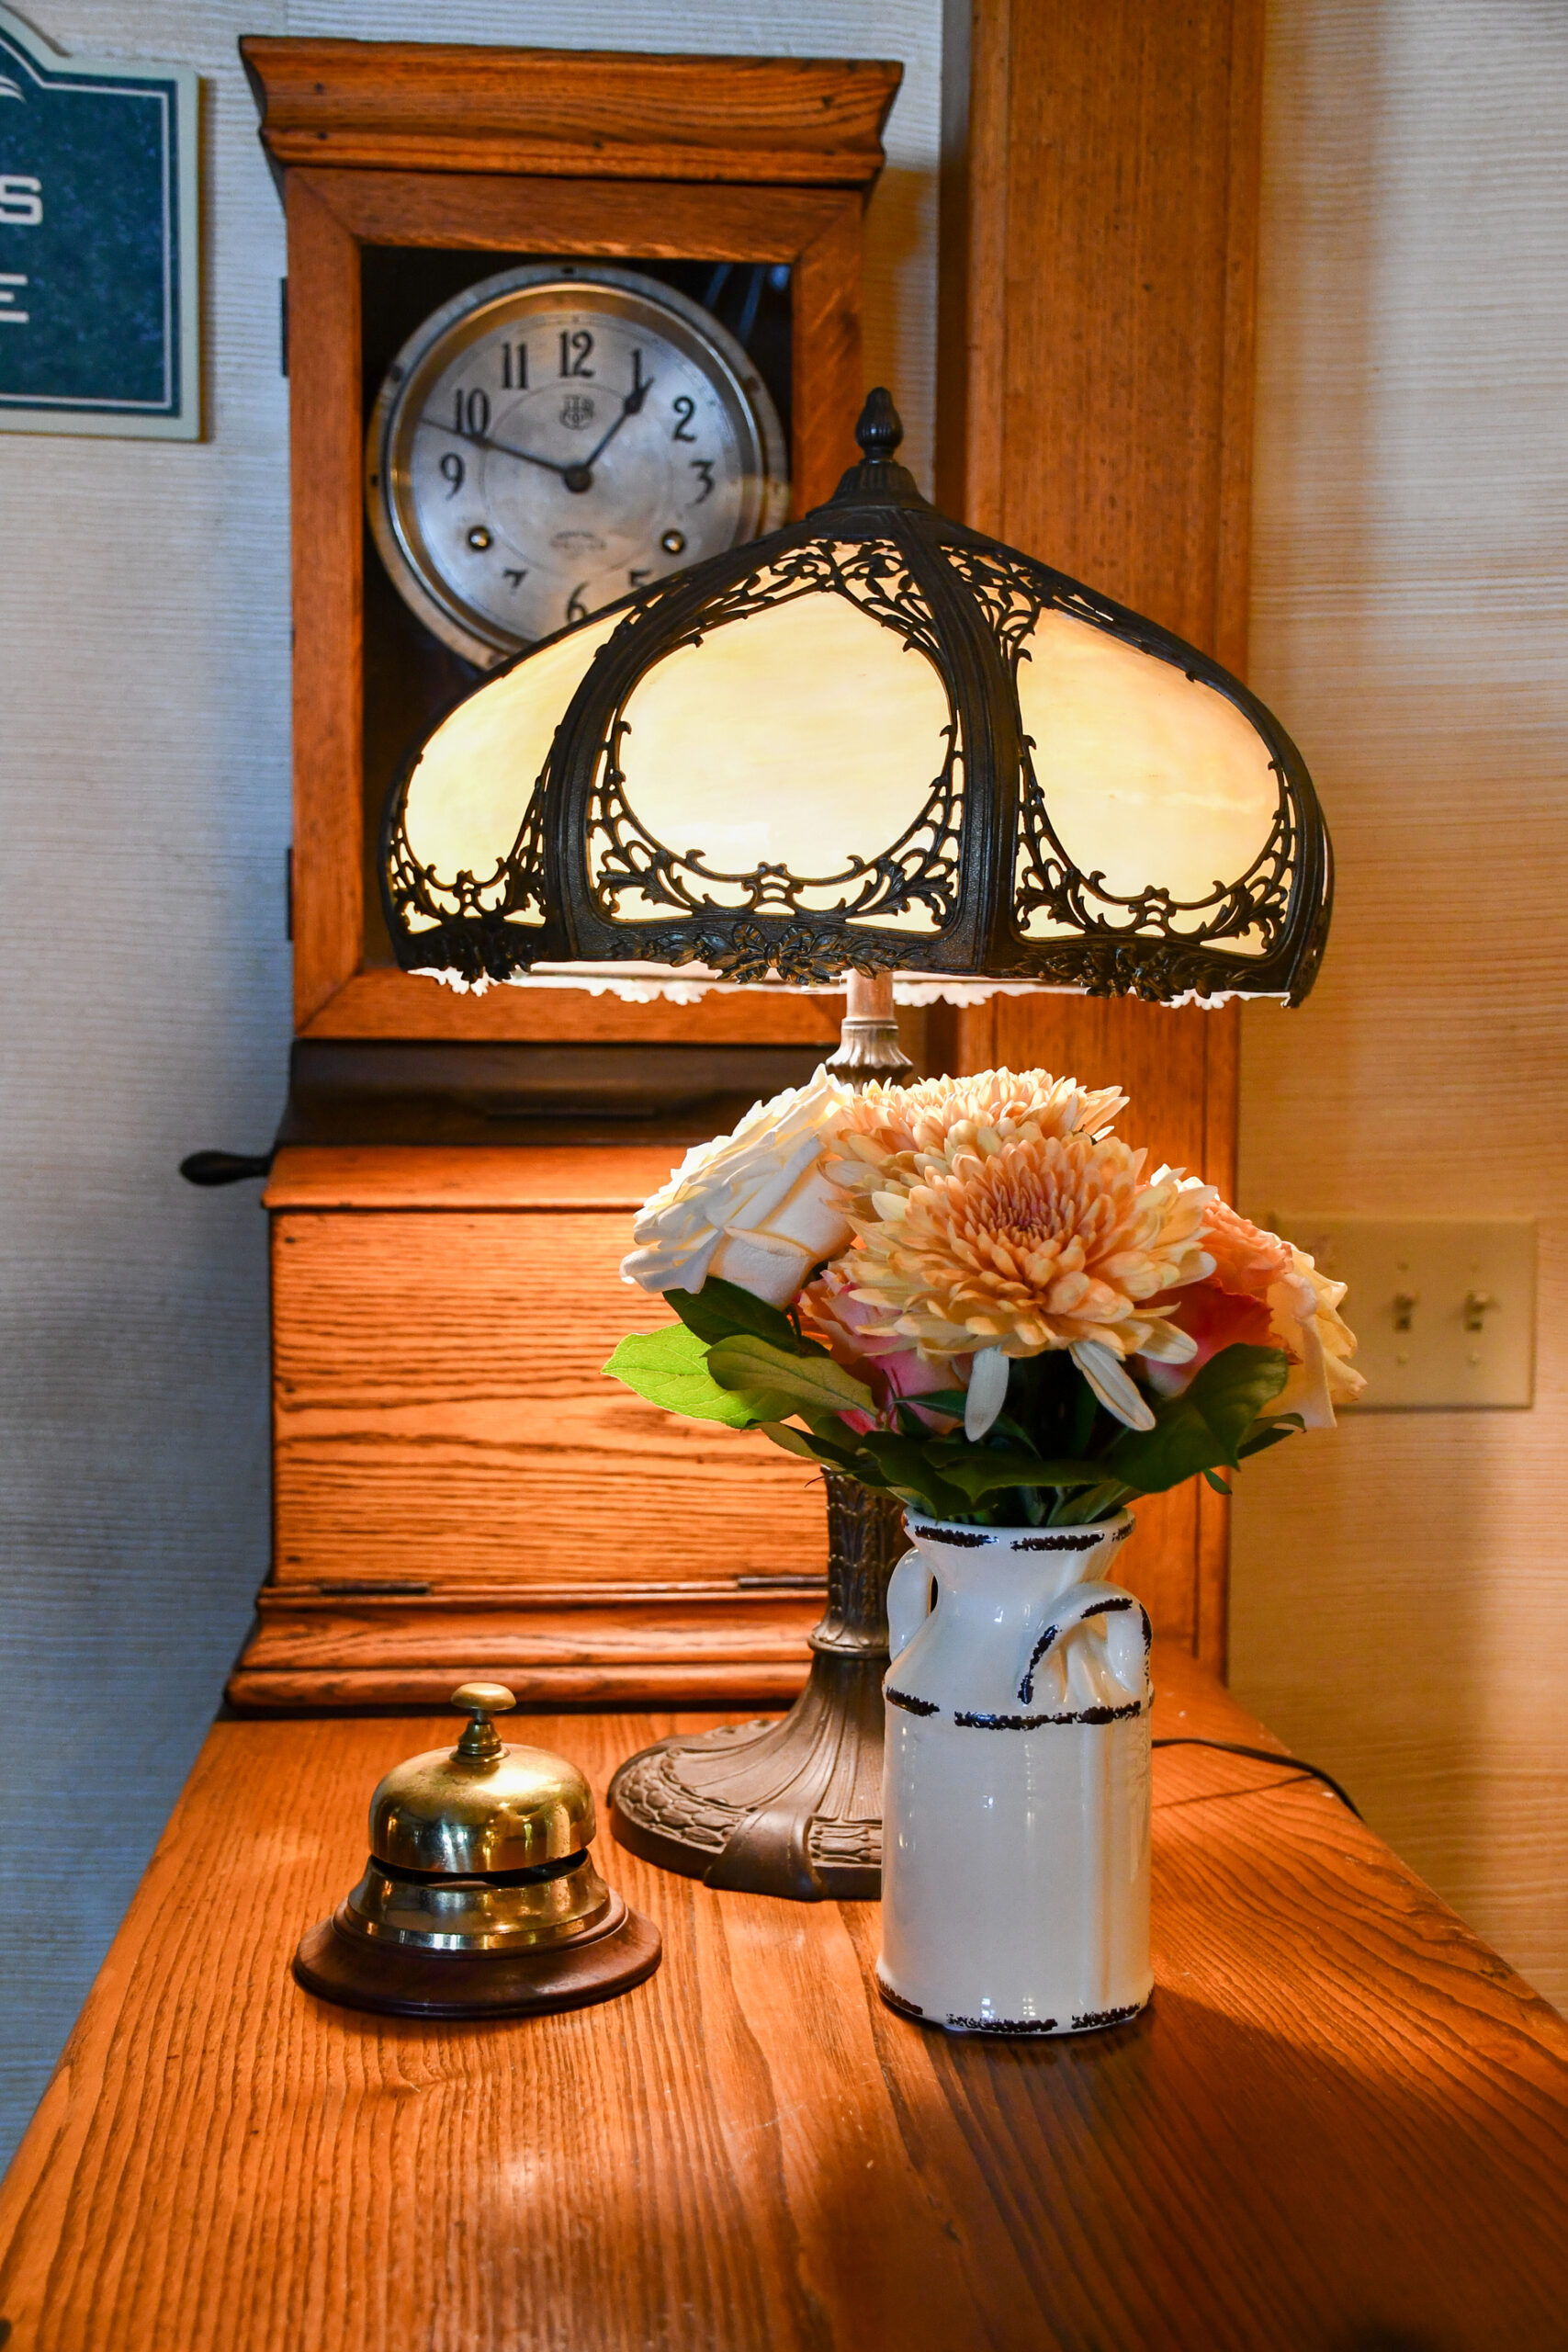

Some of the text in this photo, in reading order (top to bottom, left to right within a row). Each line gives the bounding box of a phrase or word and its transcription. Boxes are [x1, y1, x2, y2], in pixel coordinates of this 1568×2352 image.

[501, 343, 529, 390] 11
[558, 330, 594, 378] 12
[631, 348, 646, 390] 1
[455, 389, 491, 435] 10
[673, 397, 695, 442] 2
[440, 452, 464, 499] 9
[689, 461, 715, 506] 3
[567, 582, 587, 622] 6
